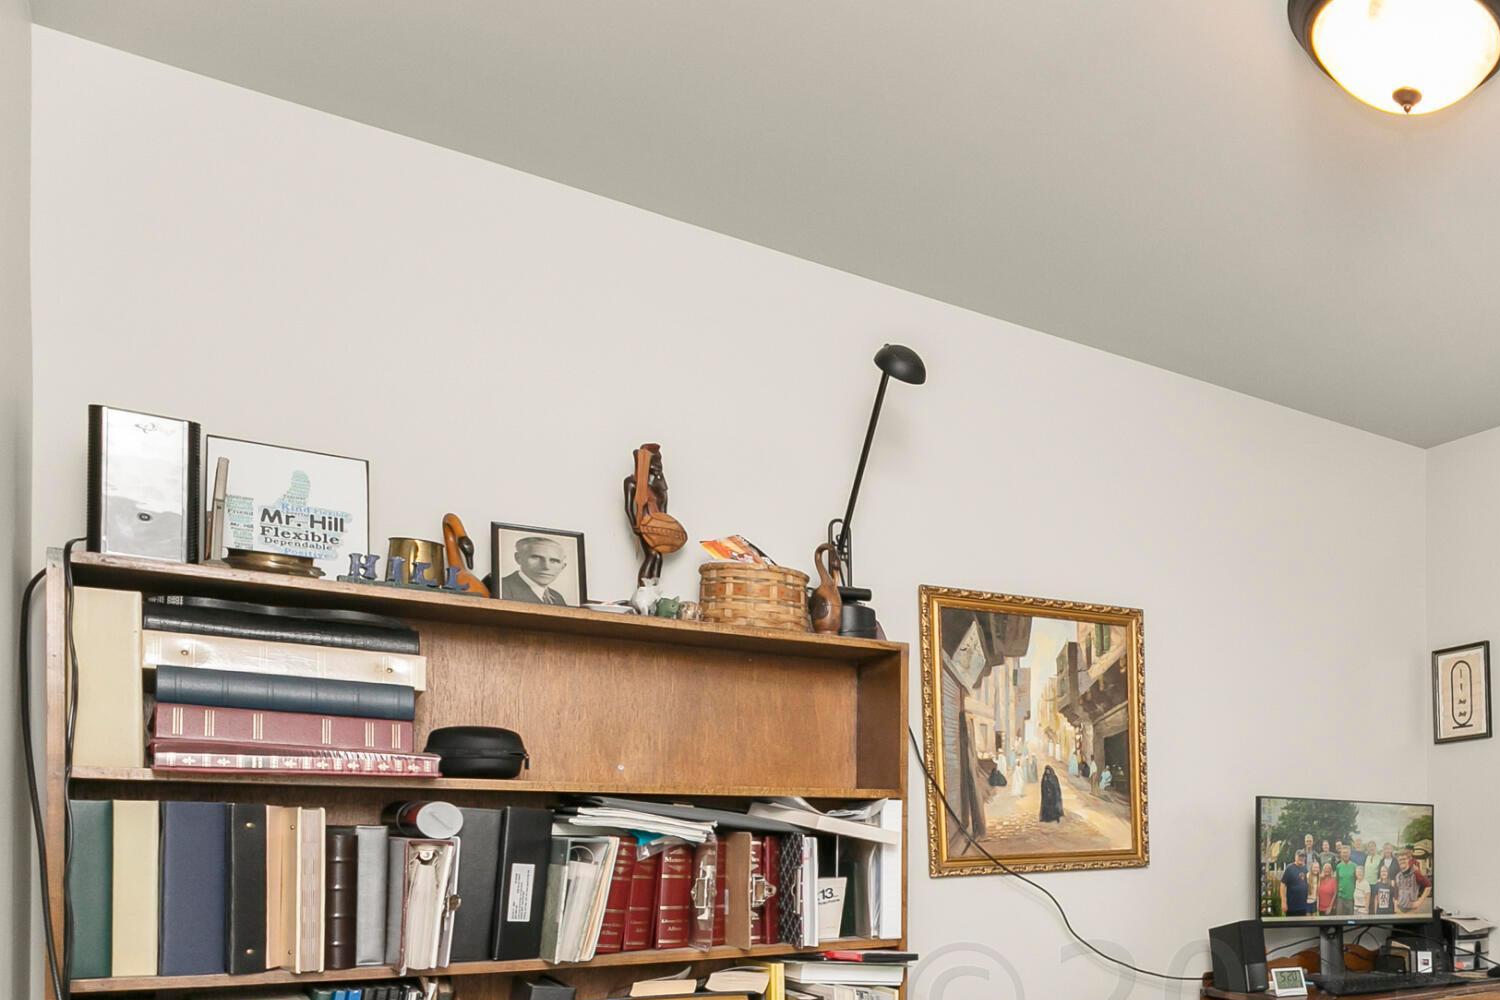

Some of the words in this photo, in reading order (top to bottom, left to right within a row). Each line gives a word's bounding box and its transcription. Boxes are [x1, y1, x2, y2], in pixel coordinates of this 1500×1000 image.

[260, 508, 302, 527] Mr.
[310, 514, 344, 532] Hill
[260, 526, 340, 545] Flexible
[264, 537, 332, 551] Dependable
